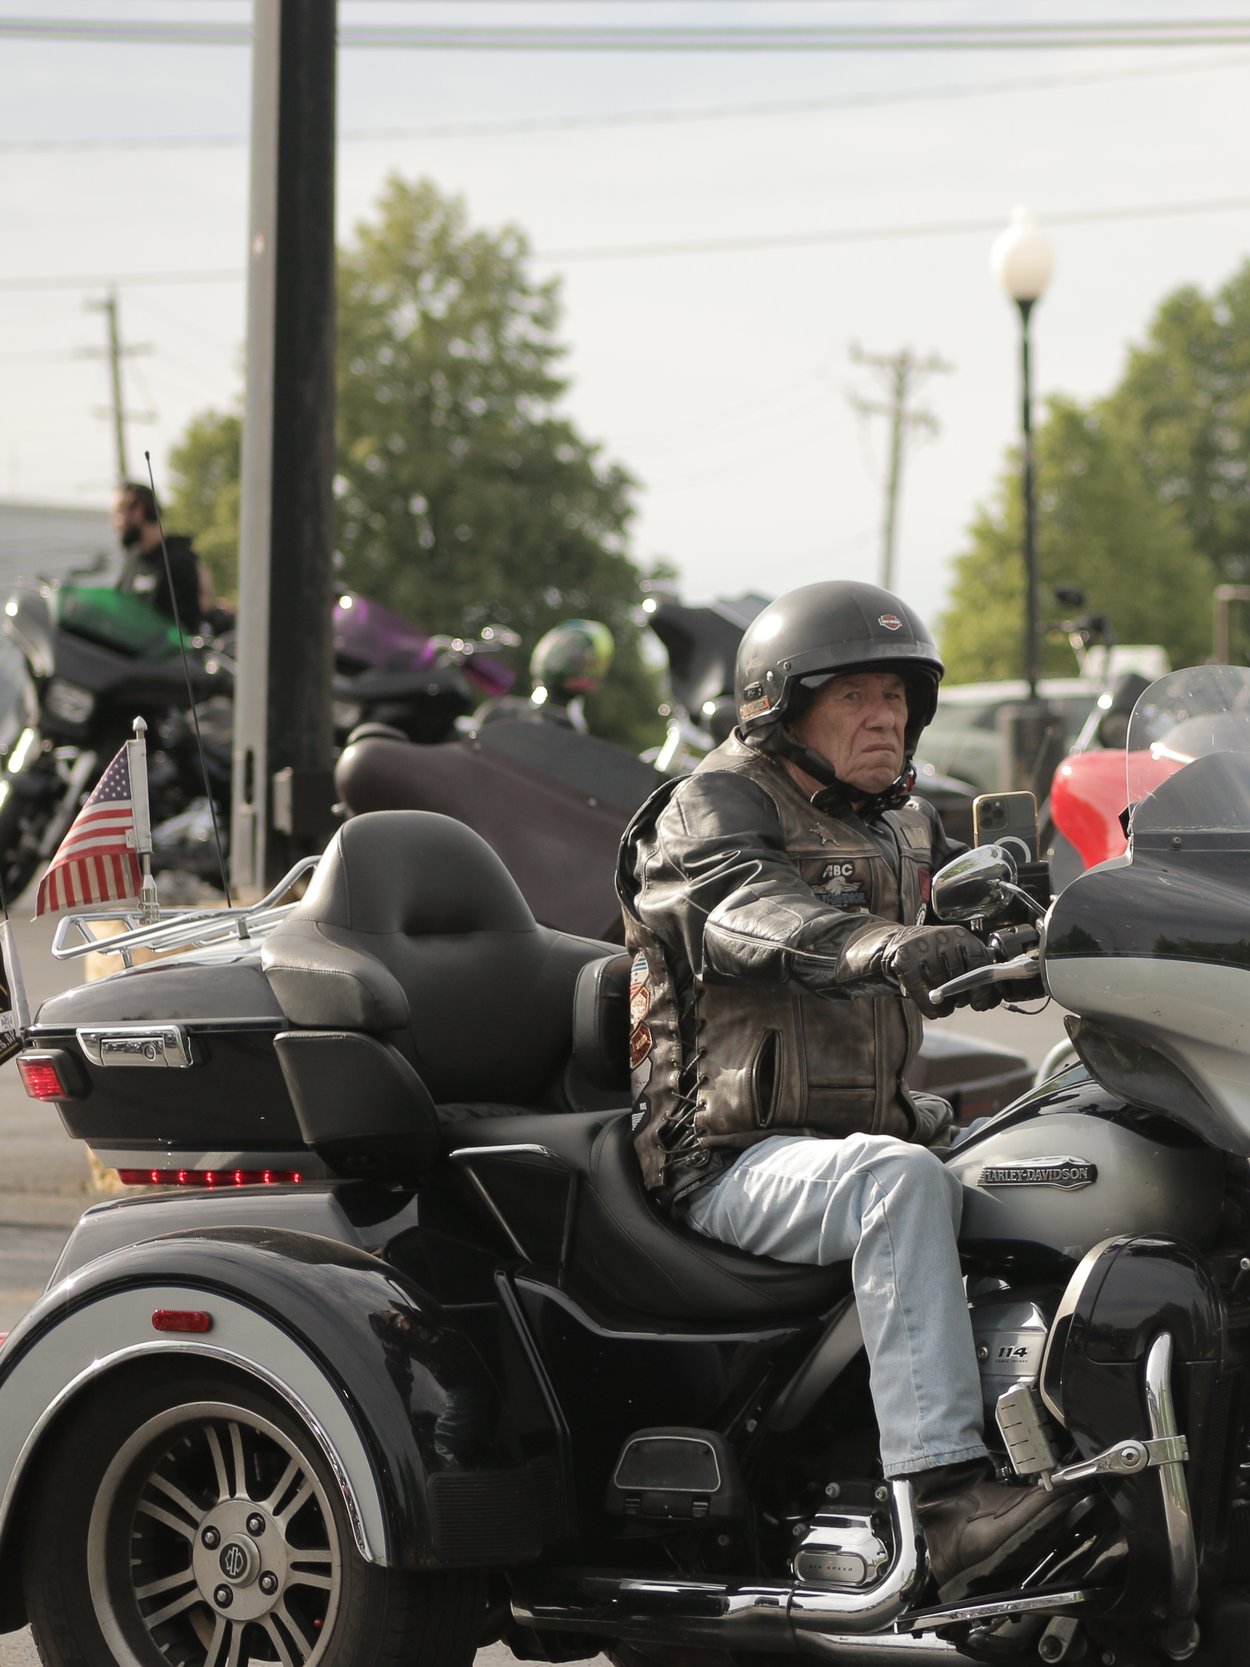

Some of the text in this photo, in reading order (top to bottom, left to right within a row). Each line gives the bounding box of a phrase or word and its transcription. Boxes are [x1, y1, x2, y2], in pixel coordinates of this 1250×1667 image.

[822, 864, 853, 878] ABC
[984, 1167, 1088, 1182] HARLEY-DAVIDSON
[998, 1346, 1028, 1358] 114
